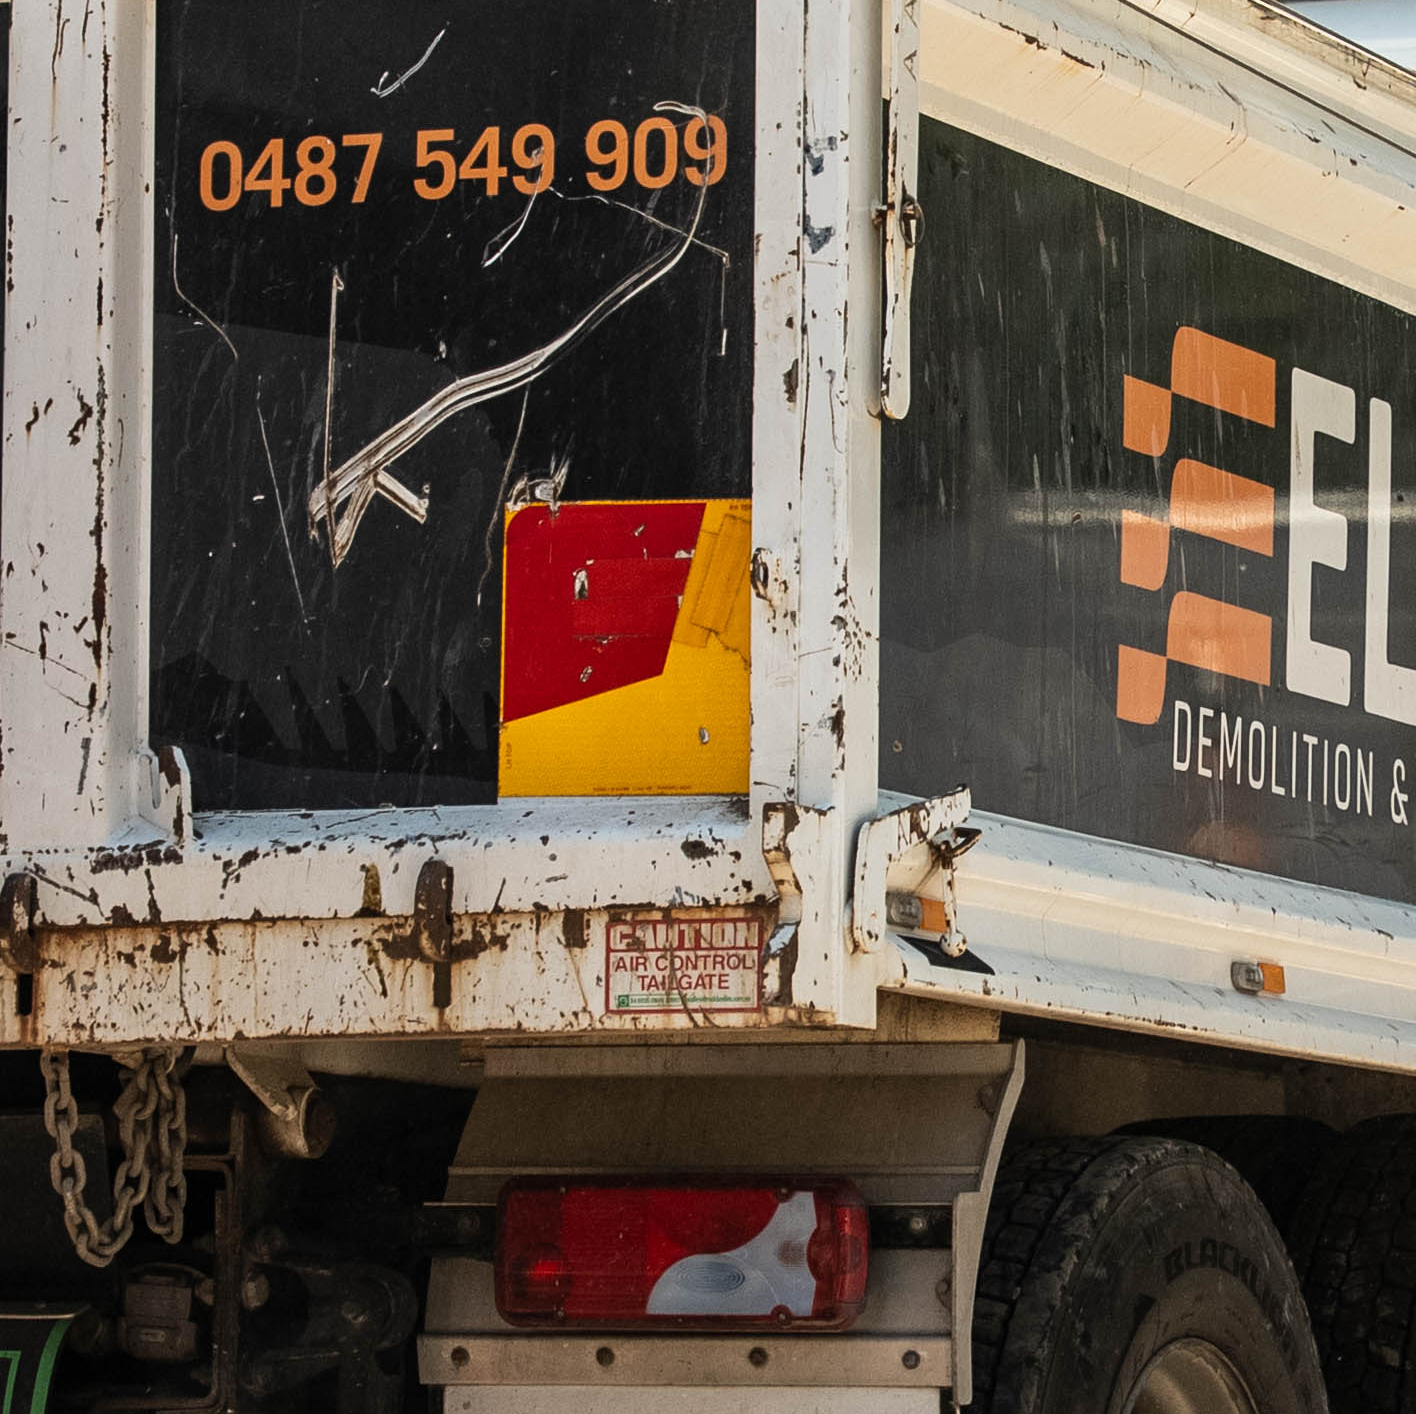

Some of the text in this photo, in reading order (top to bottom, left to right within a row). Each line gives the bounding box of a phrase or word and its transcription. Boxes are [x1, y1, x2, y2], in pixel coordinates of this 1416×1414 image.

[200, 115, 728, 212] 0487 549 909
[1172, 699, 1374, 818] DEMOLITION
[1389, 758, 1409, 826] &
[609, 922, 759, 950] CAUTION
[614, 953, 755, 972] AIR CONTROL
[637, 973, 730, 992] TAILGATE
